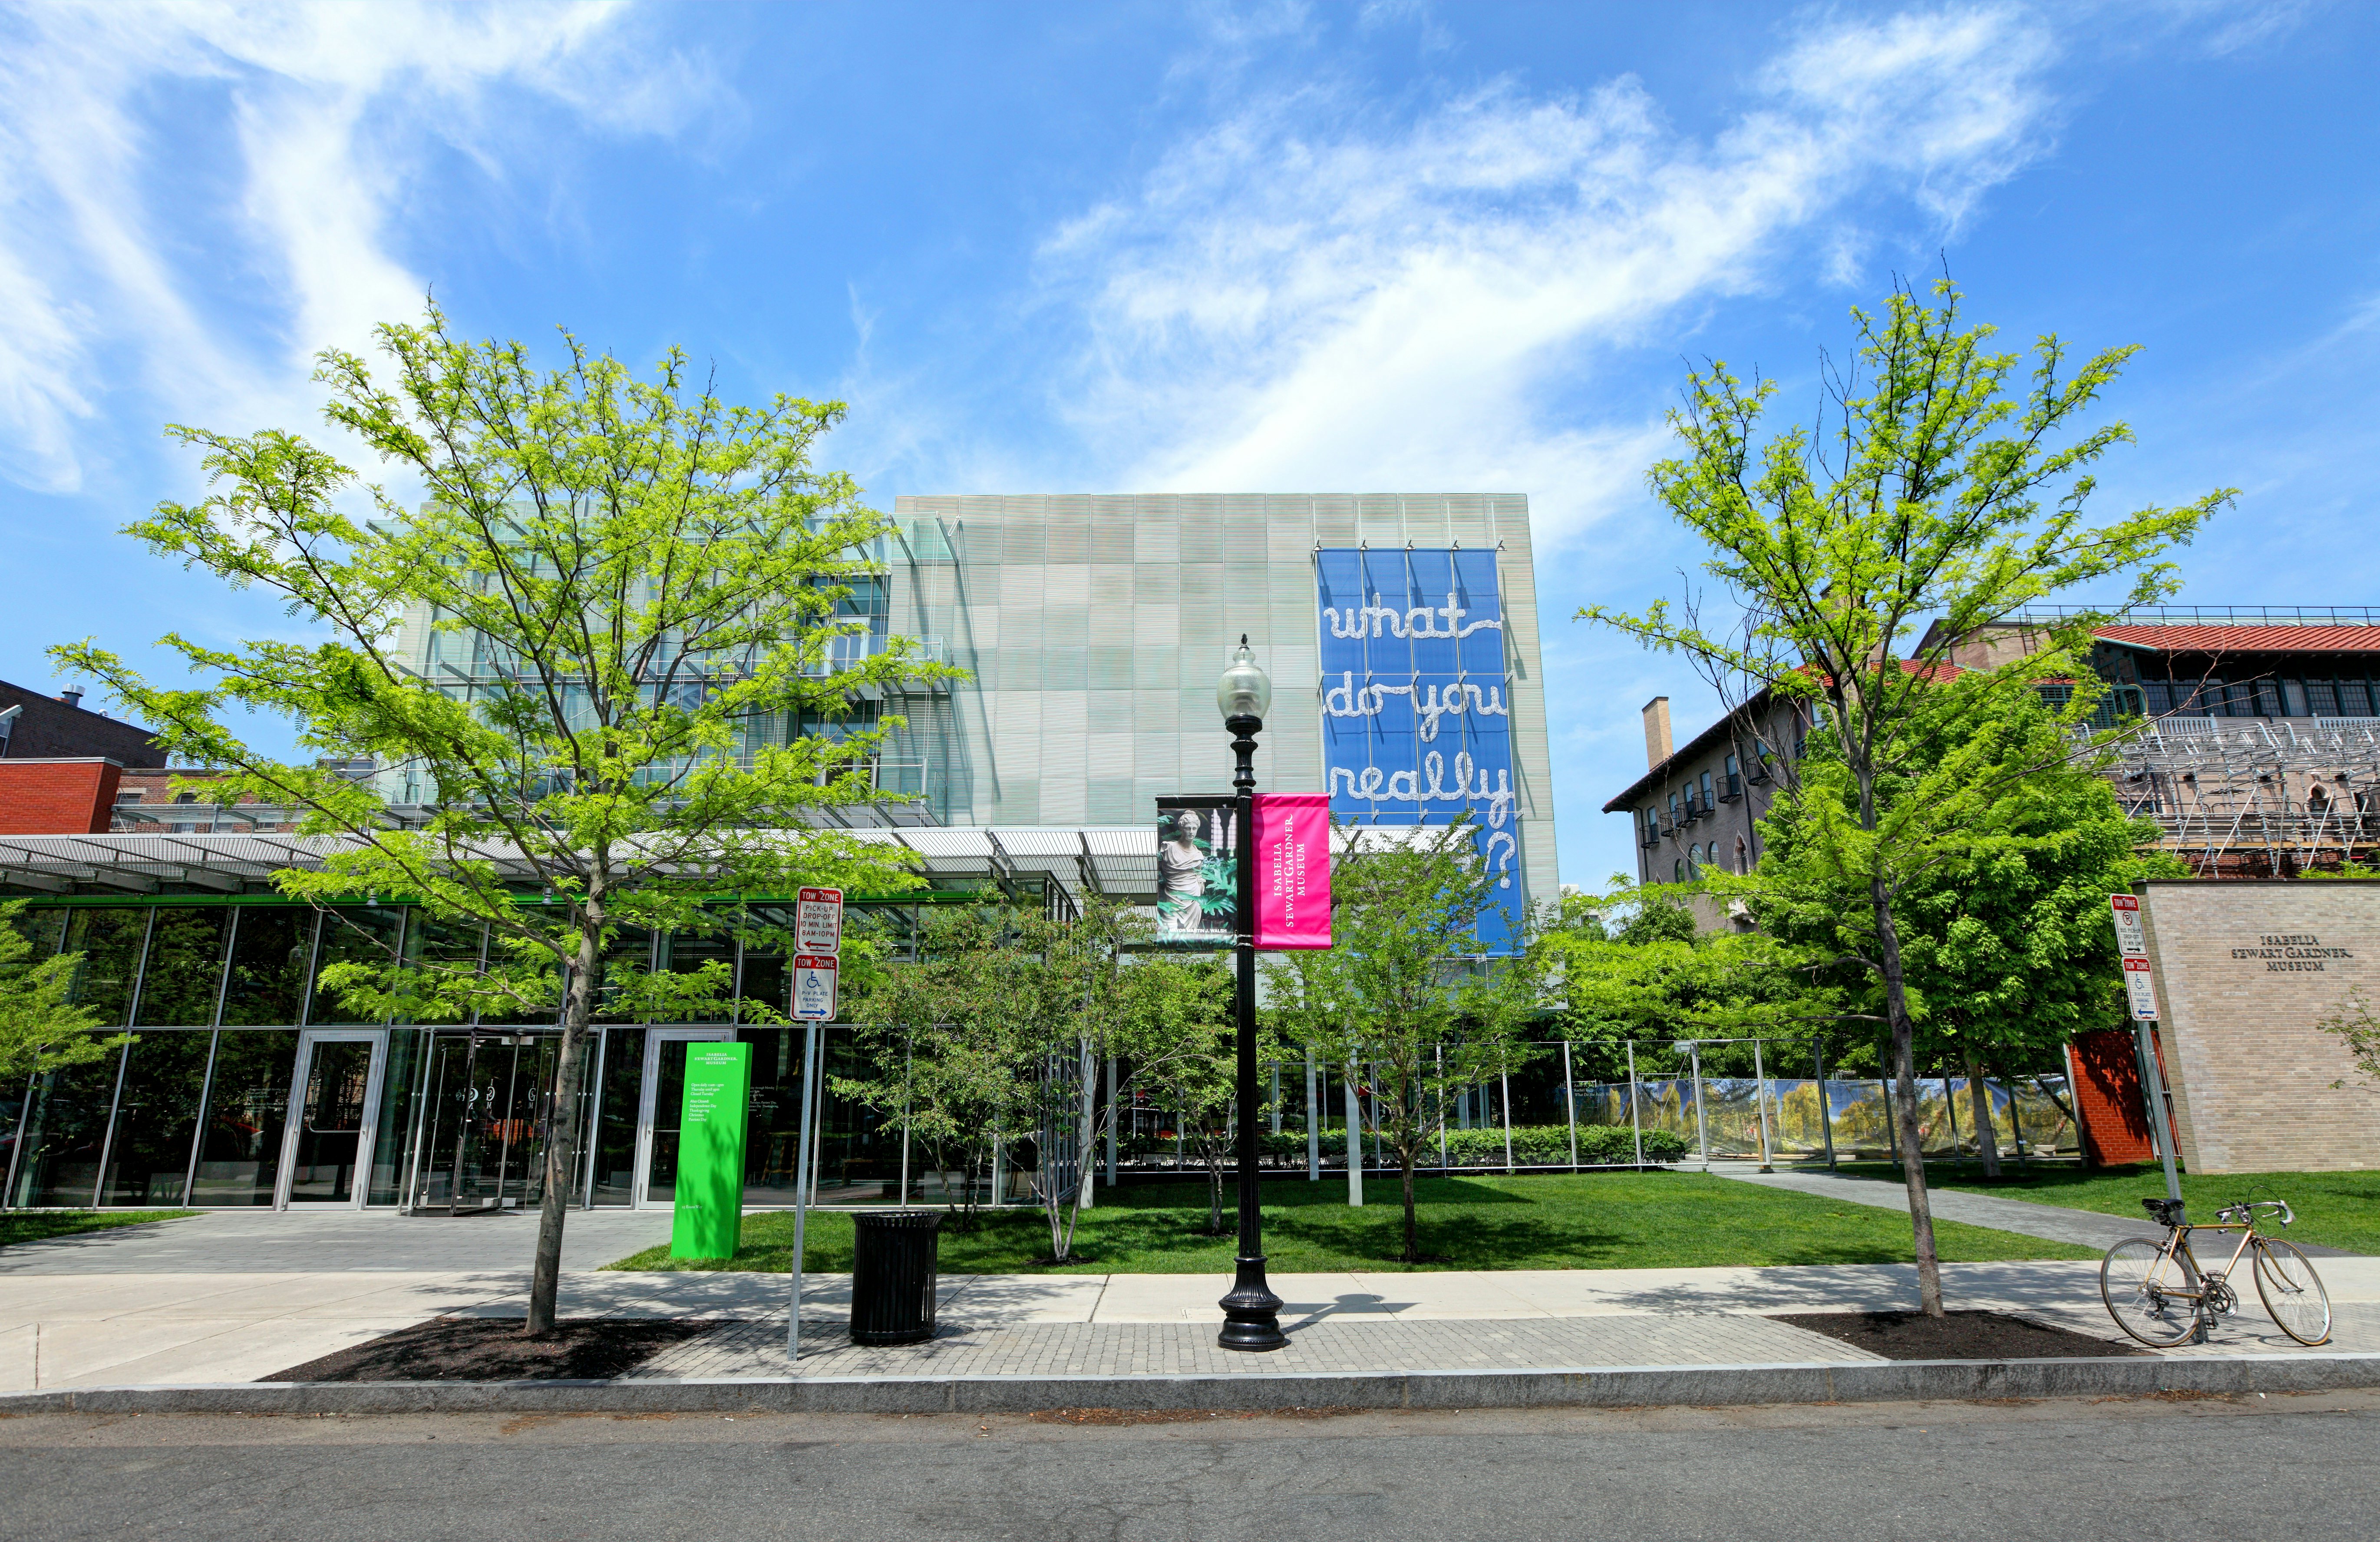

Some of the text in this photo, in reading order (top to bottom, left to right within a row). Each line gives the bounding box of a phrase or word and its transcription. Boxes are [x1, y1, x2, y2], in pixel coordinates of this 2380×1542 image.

[1323, 592, 1502, 639] what
[1323, 671, 1508, 742] do you
[1330, 751, 1515, 829] really
[1284, 814, 1294, 877] GARDNER
[1297, 843, 1305, 897] MUSEUM
[820, 893, 839, 901] ZONE
[2260, 936, 2320, 945] ISABELLA
[2285, 947, 2354, 959] GARDNER
[797, 958, 835, 968] TOW ZONE
[2266, 961, 2324, 972] MUSEUM
